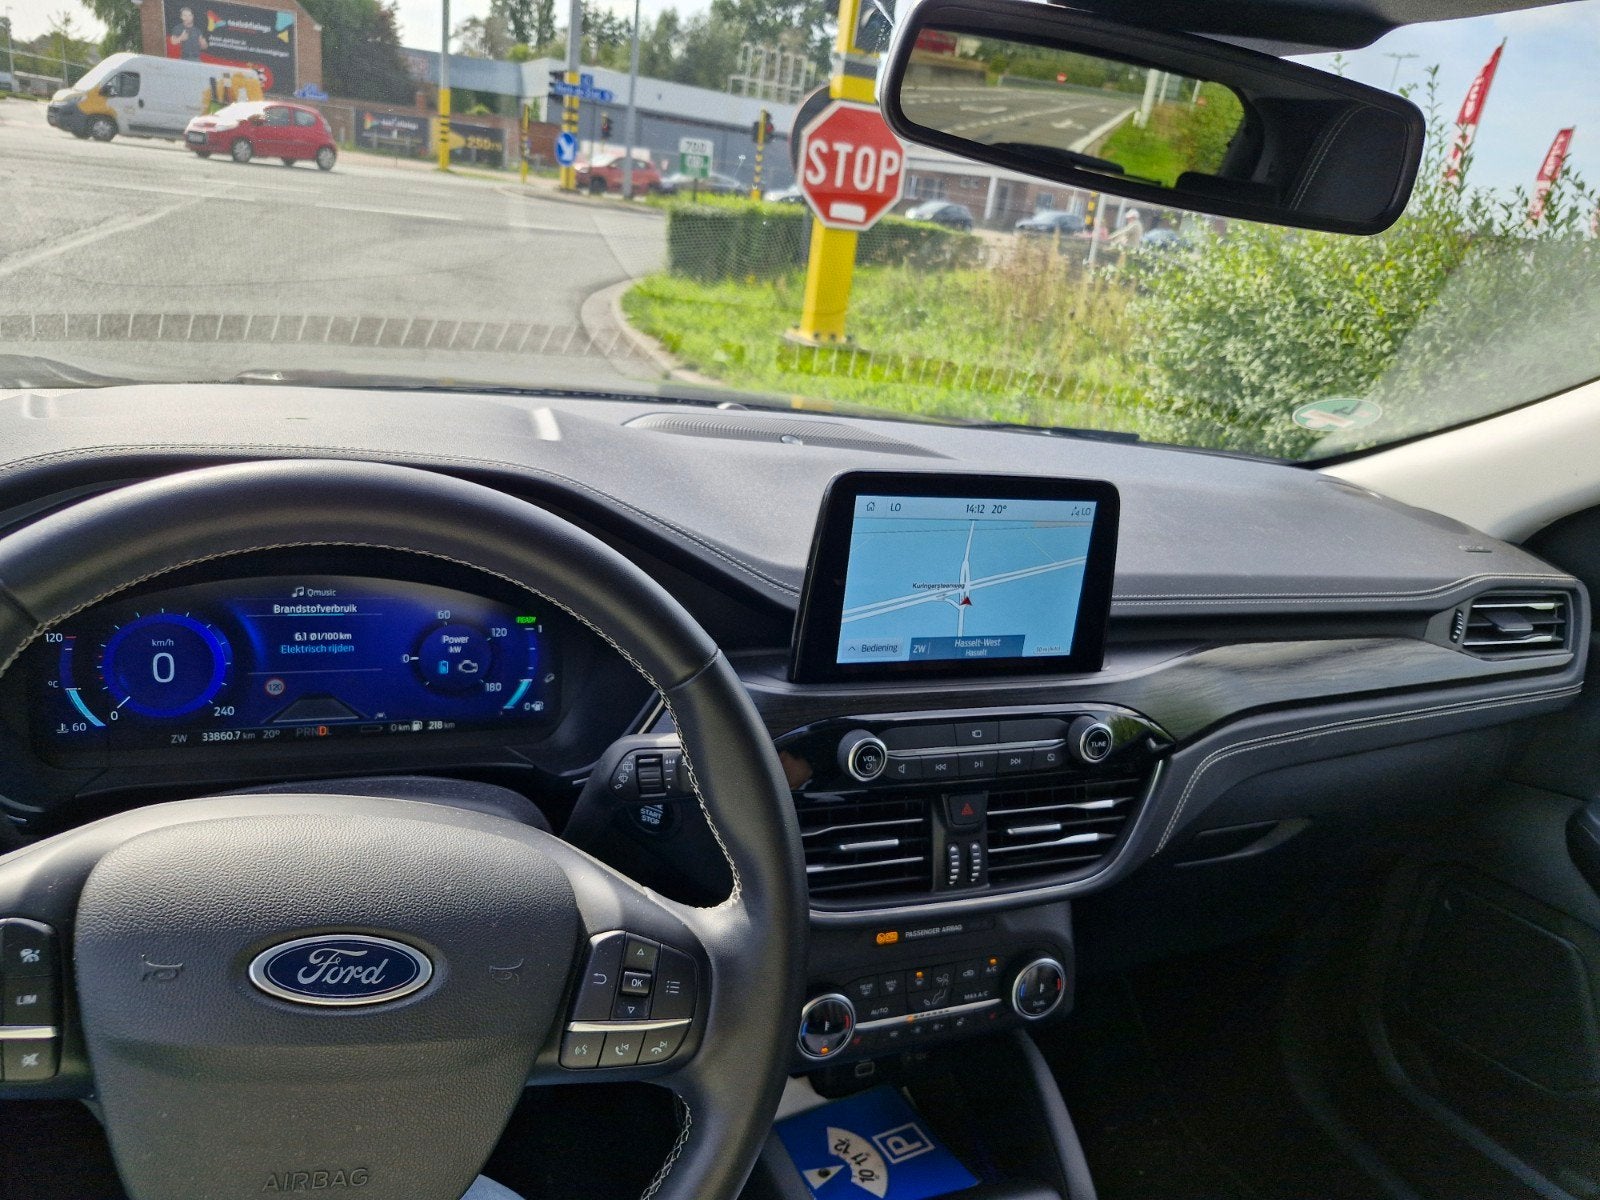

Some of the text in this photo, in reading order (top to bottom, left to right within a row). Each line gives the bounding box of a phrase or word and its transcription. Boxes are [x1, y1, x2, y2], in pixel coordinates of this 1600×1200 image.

[805, 139, 901, 194] STOP
[890, 502, 902, 512] LO
[965, 504, 986, 514] 14:12
[1081, 507, 1092, 516] LO
[307, 588, 337, 597] Qmusic
[273, 604, 358, 614] Brandstofverbruik
[438, 610, 451, 619] 60
[294, 632, 307, 642] 6.1
[340, 631, 352, 640] km
[491, 628, 508, 637] 120
[45, 633, 63, 643] 120
[151, 638, 175, 647] km/h
[442, 635, 470, 644] Power
[954, 638, 1002, 648] Hasselt-West
[281, 643, 355, 654] Elektrisch rijden
[861, 643, 898, 654] Bediening
[912, 644, 927, 654] ZW
[965, 648, 988, 657] Hasselt
[402, 654, 410, 663] 0
[152, 652, 176, 684] 0
[267, 683, 283, 692] 120
[485, 682, 502, 692] 180
[110, 711, 119, 721] 0
[214, 706, 236, 717] 240
[72, 722, 87, 732] 60
[428, 720, 443, 730] 218
[170, 734, 188, 744] ZW
[202, 731, 241, 742] 33860.7
[1090, 739, 1107, 748] TUNE
[862, 755, 877, 764] VOL
[905, 927, 940, 938] PASSENGER
[941, 924, 963, 933] AIRBAG
[297, 948, 387, 985] Ford
[631, 978, 644, 989] OK
[834, 1138, 850, 1154] 12
[886, 1135, 922, 1156] P
[262, 1168, 369, 1193] AIRBAG
[858, 1169, 875, 1182] 10
